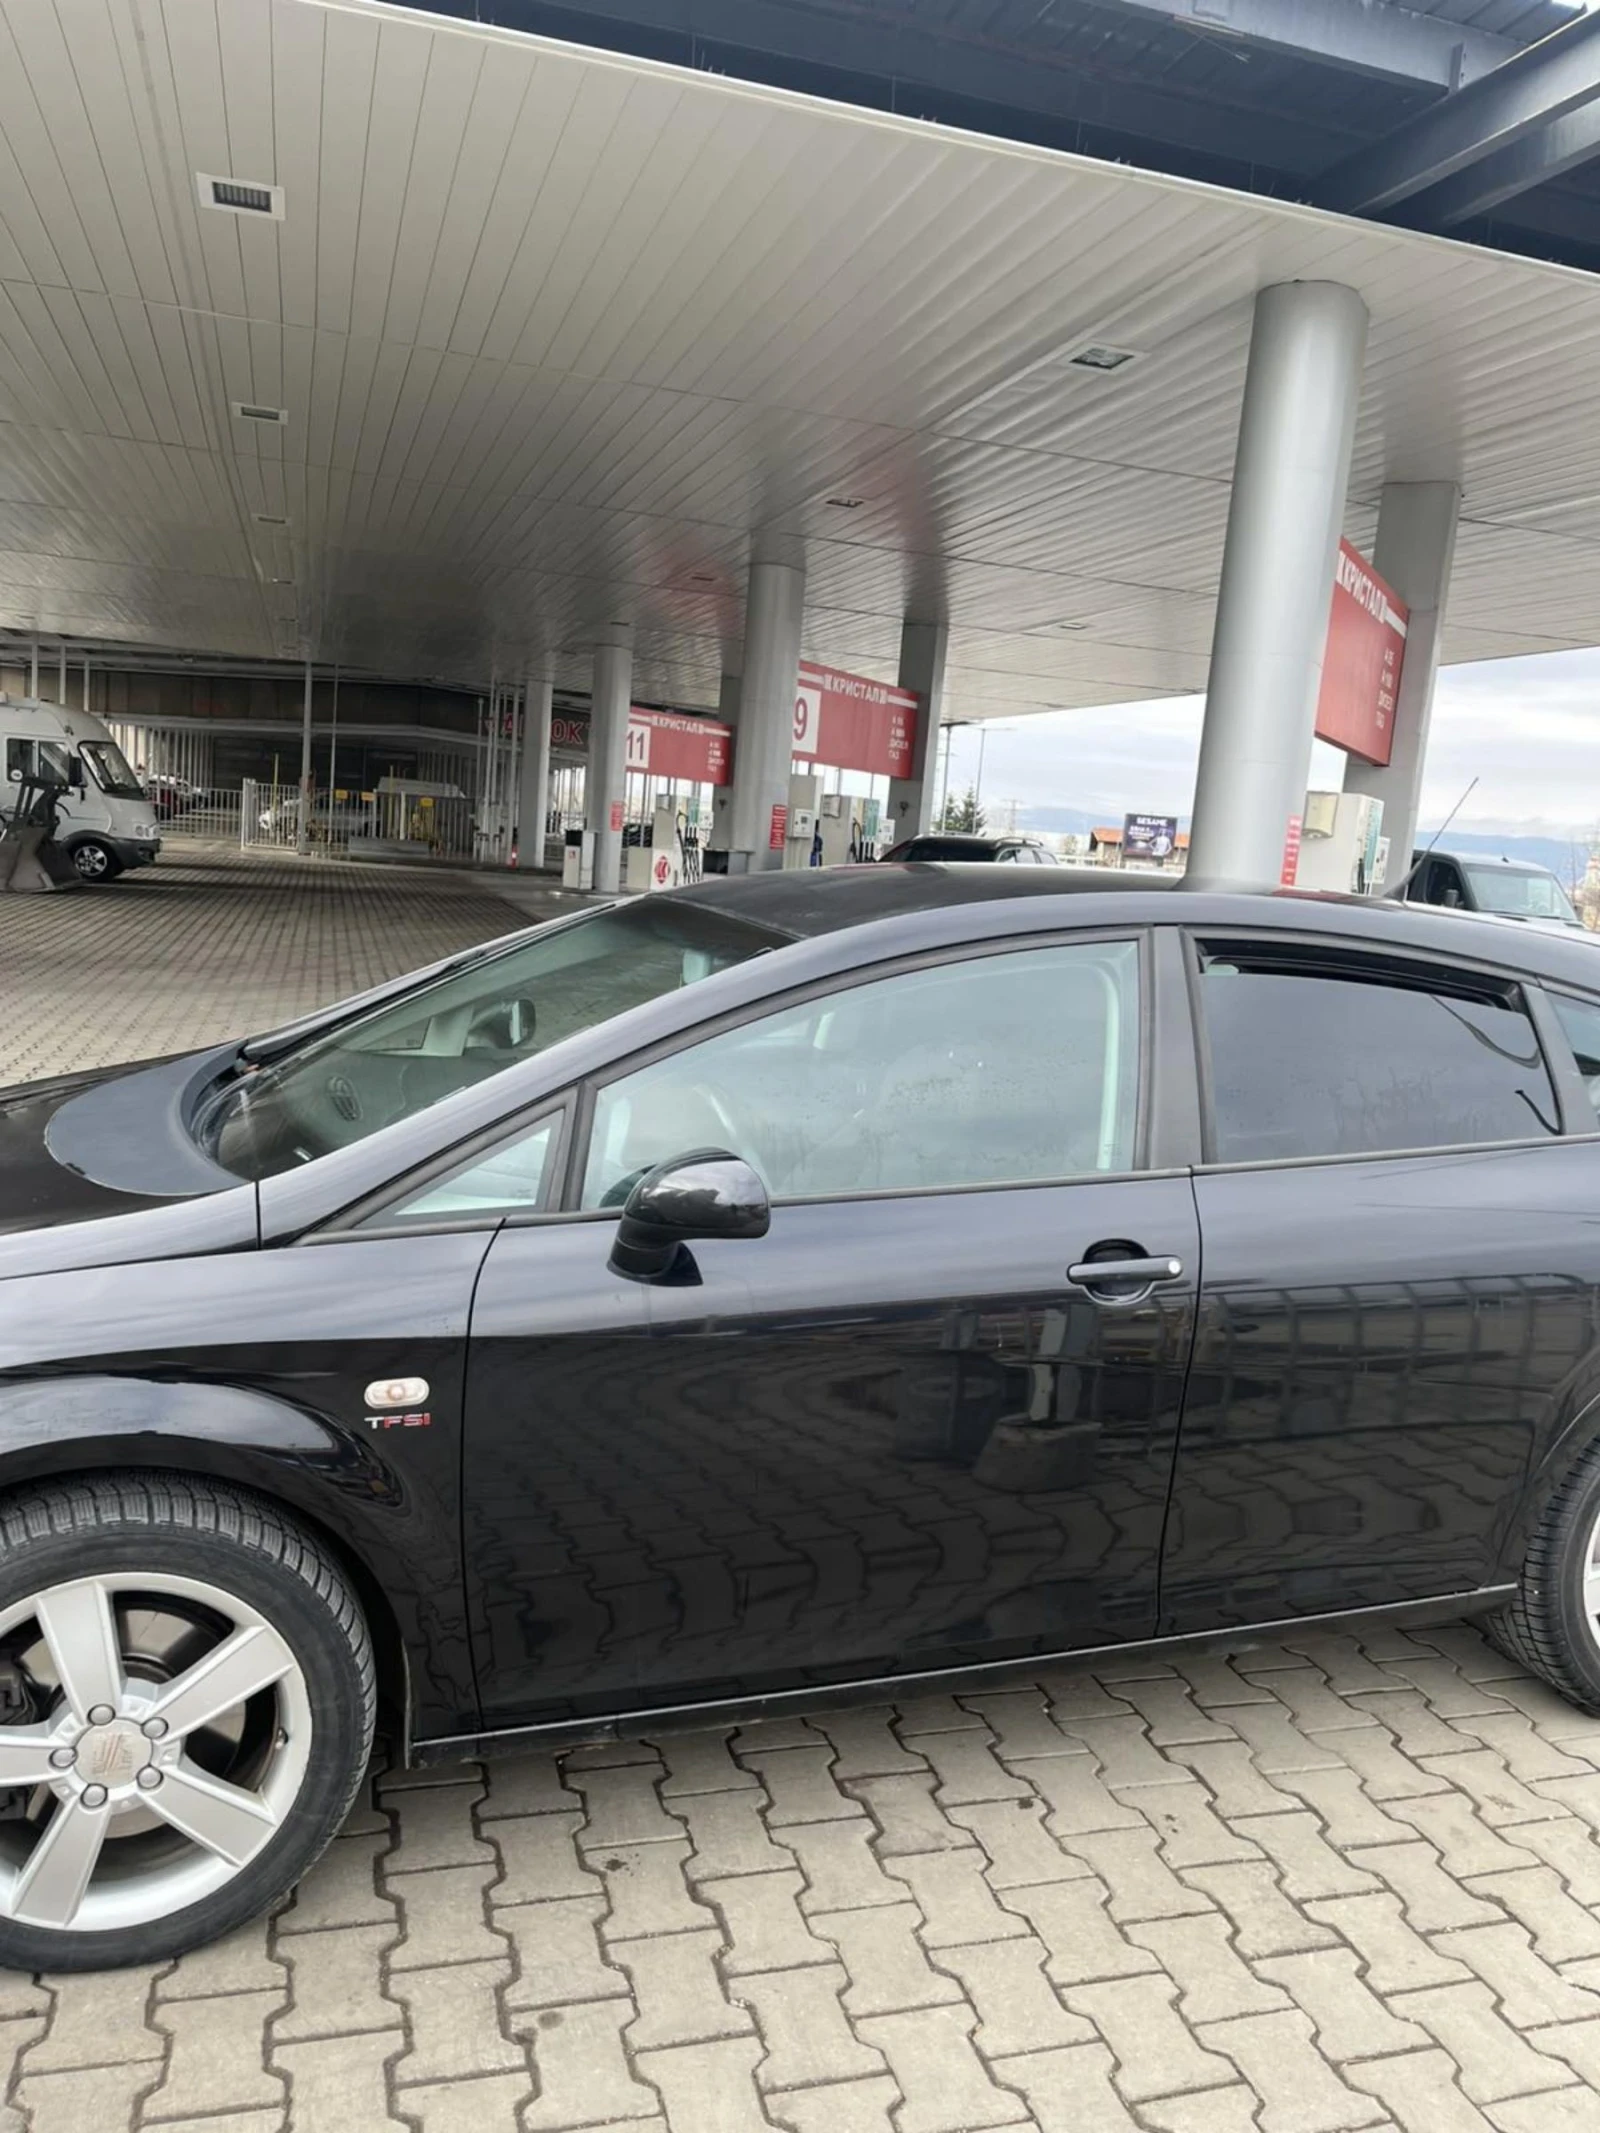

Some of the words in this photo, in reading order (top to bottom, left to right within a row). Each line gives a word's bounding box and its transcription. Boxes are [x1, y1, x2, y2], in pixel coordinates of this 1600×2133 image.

[1342, 557, 1382, 618] КРИСТАЛ
[832, 677, 880, 703] КРИСТАЛ
[658, 717, 700, 734] КРИСТАЛ
[793, 697, 808, 741] 9
[626, 730, 645, 760] 11
[364, 1412, 431, 1430] TFSI
